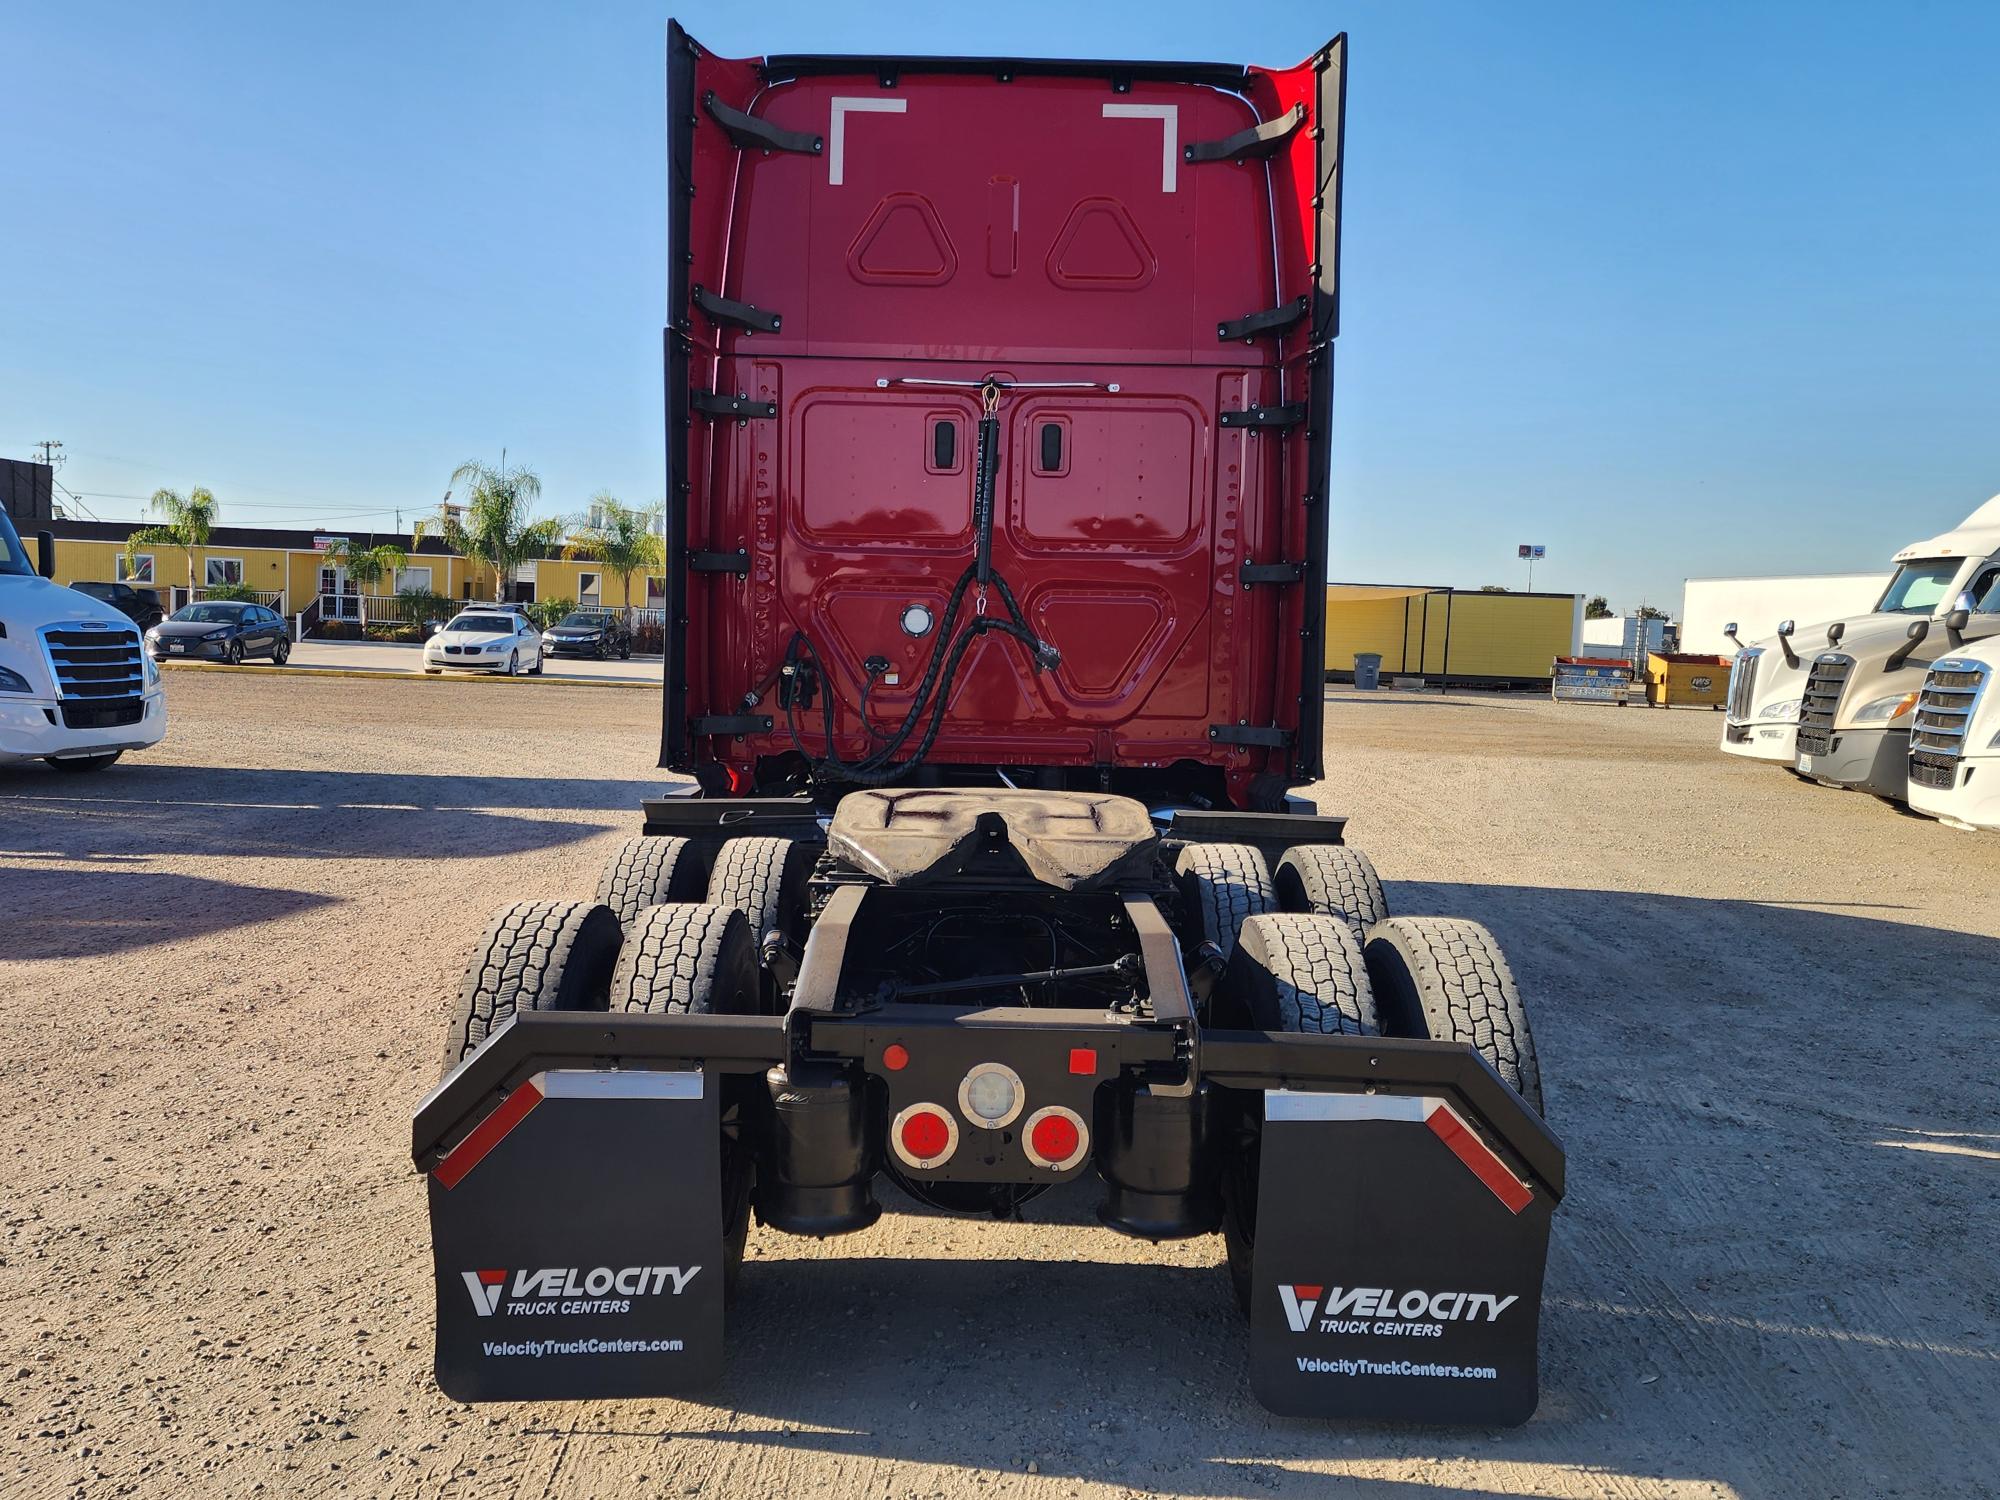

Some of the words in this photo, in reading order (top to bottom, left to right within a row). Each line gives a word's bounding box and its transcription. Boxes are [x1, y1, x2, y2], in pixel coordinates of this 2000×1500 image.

[976, 443, 984, 503] TECTRAN
[510, 1266, 704, 1298] VELOCITY
[506, 1301, 557, 1316] TRUCK
[561, 1300, 631, 1315] CENTERS
[1324, 1287, 1519, 1322] VELOCITY
[1319, 1320, 1370, 1335] TRUCK
[1373, 1322, 1444, 1338] CENTERS
[482, 1337, 684, 1359] VelocityTruckCenters.com
[1296, 1357, 1497, 1379] VelocityTruckCenters.com
